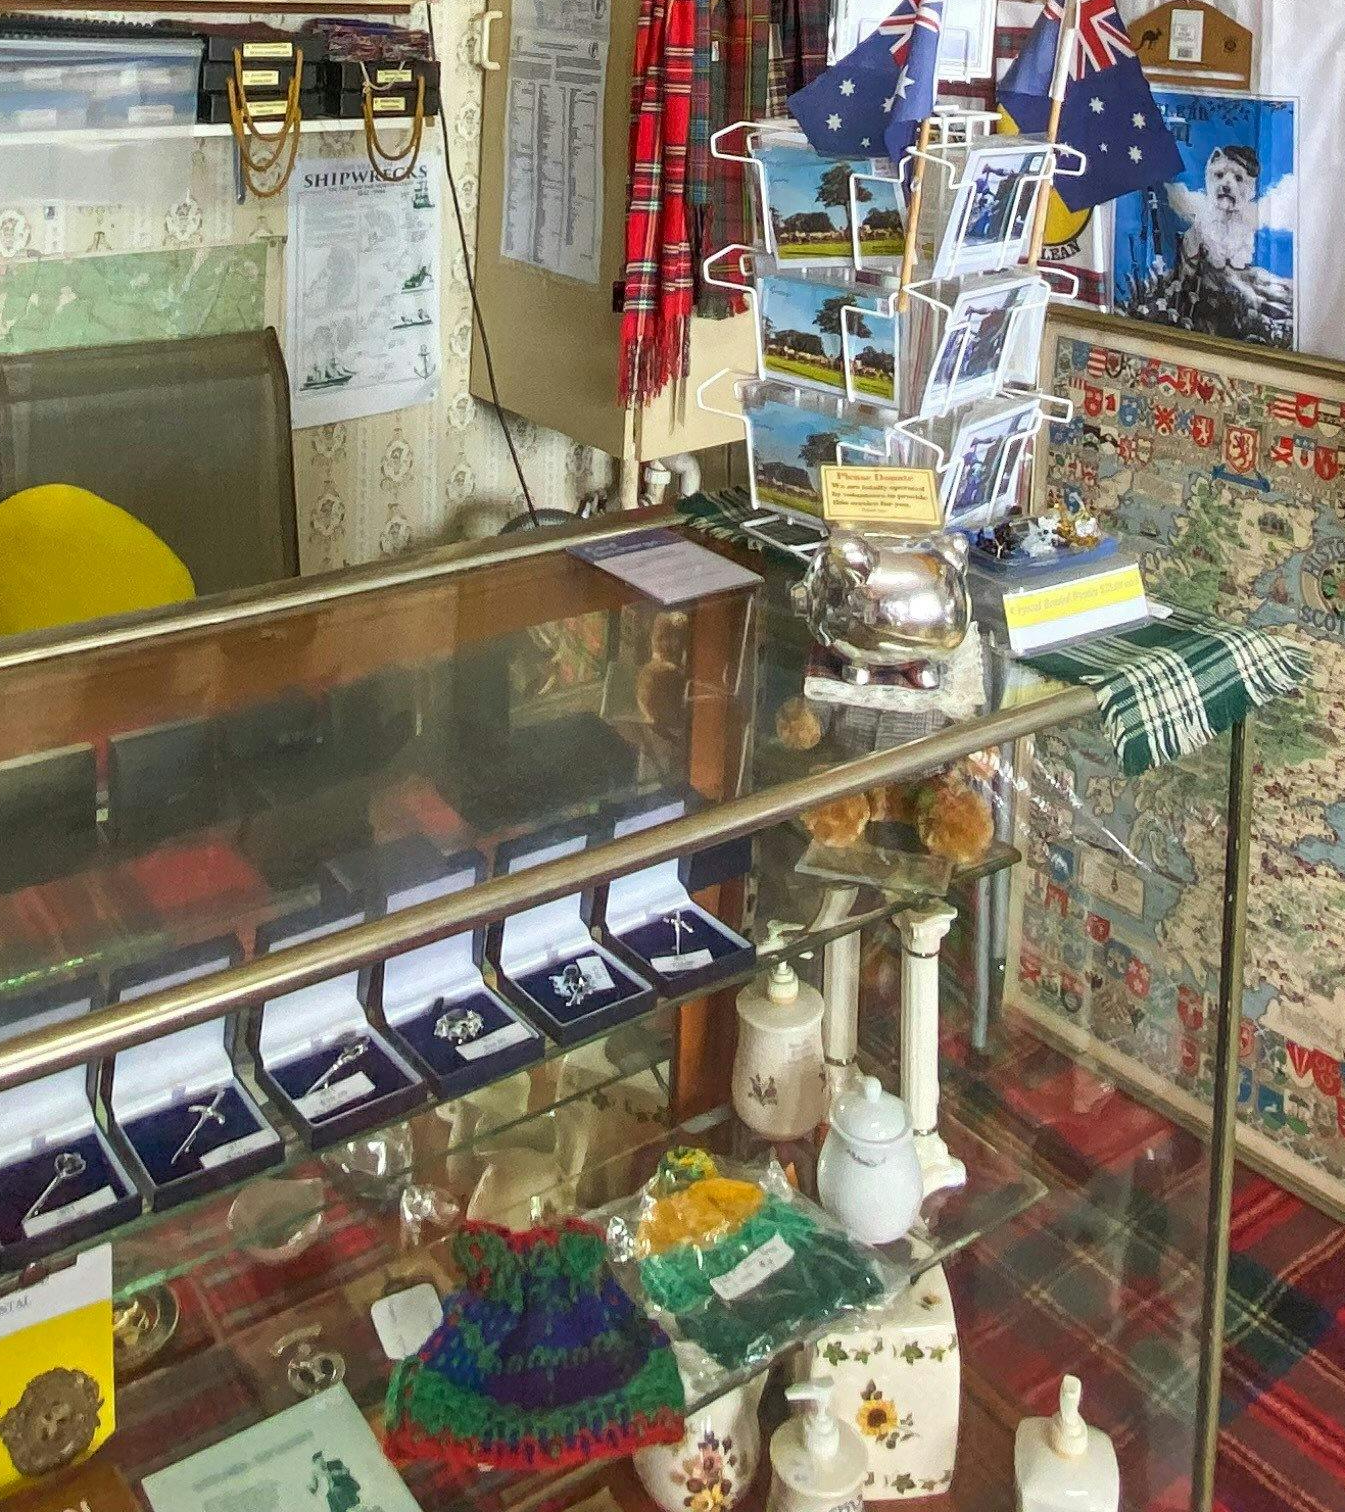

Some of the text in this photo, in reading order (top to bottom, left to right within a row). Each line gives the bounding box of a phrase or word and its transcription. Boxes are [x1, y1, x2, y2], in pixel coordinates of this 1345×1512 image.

[305, 164, 428, 189] SHIPWRECKS
[836, 472, 914, 483] Please Donate
